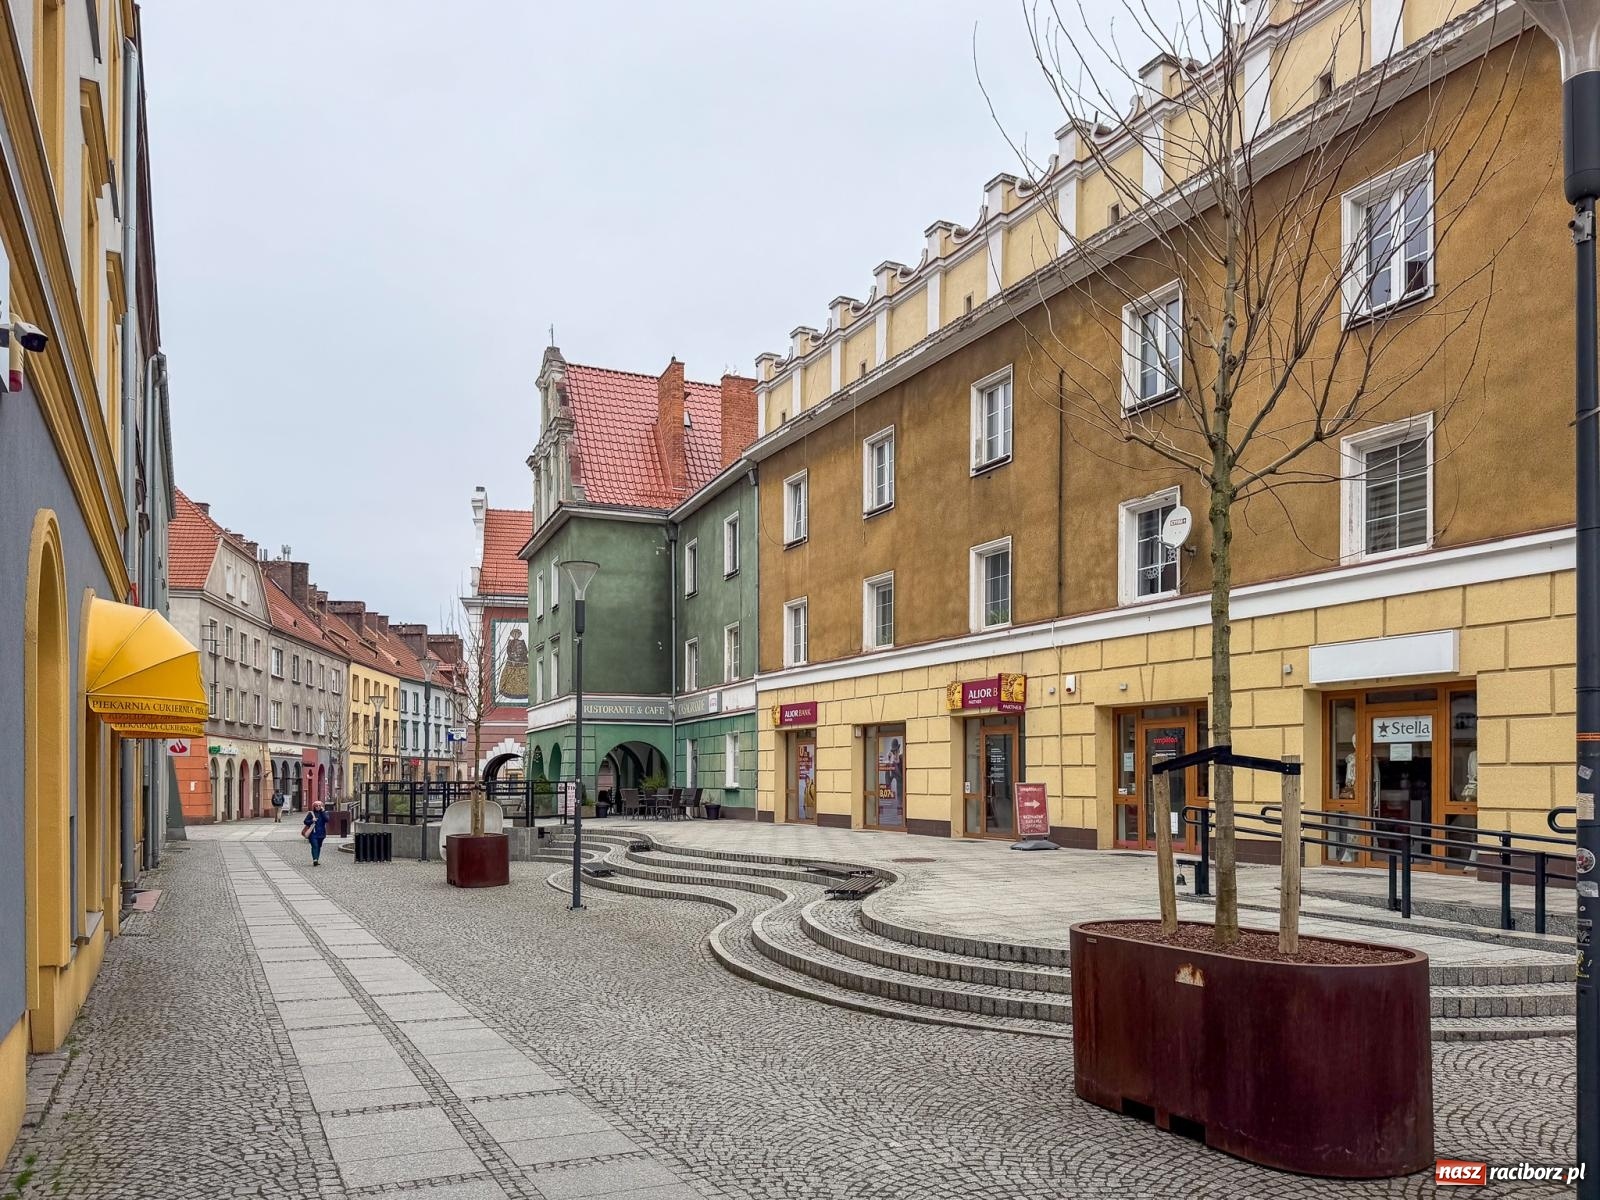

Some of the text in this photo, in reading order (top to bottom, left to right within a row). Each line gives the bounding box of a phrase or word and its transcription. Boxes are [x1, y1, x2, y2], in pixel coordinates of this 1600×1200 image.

[968, 688, 992, 699] ALIOR
[92, 700, 151, 711] PIEKARNIA
[153, 703, 194, 713] CUKIERNIA
[583, 704, 665, 715] RISTORANTE & CAFE
[784, 708, 811, 718] ALIOR BANK
[1391, 720, 1430, 735] Stella
